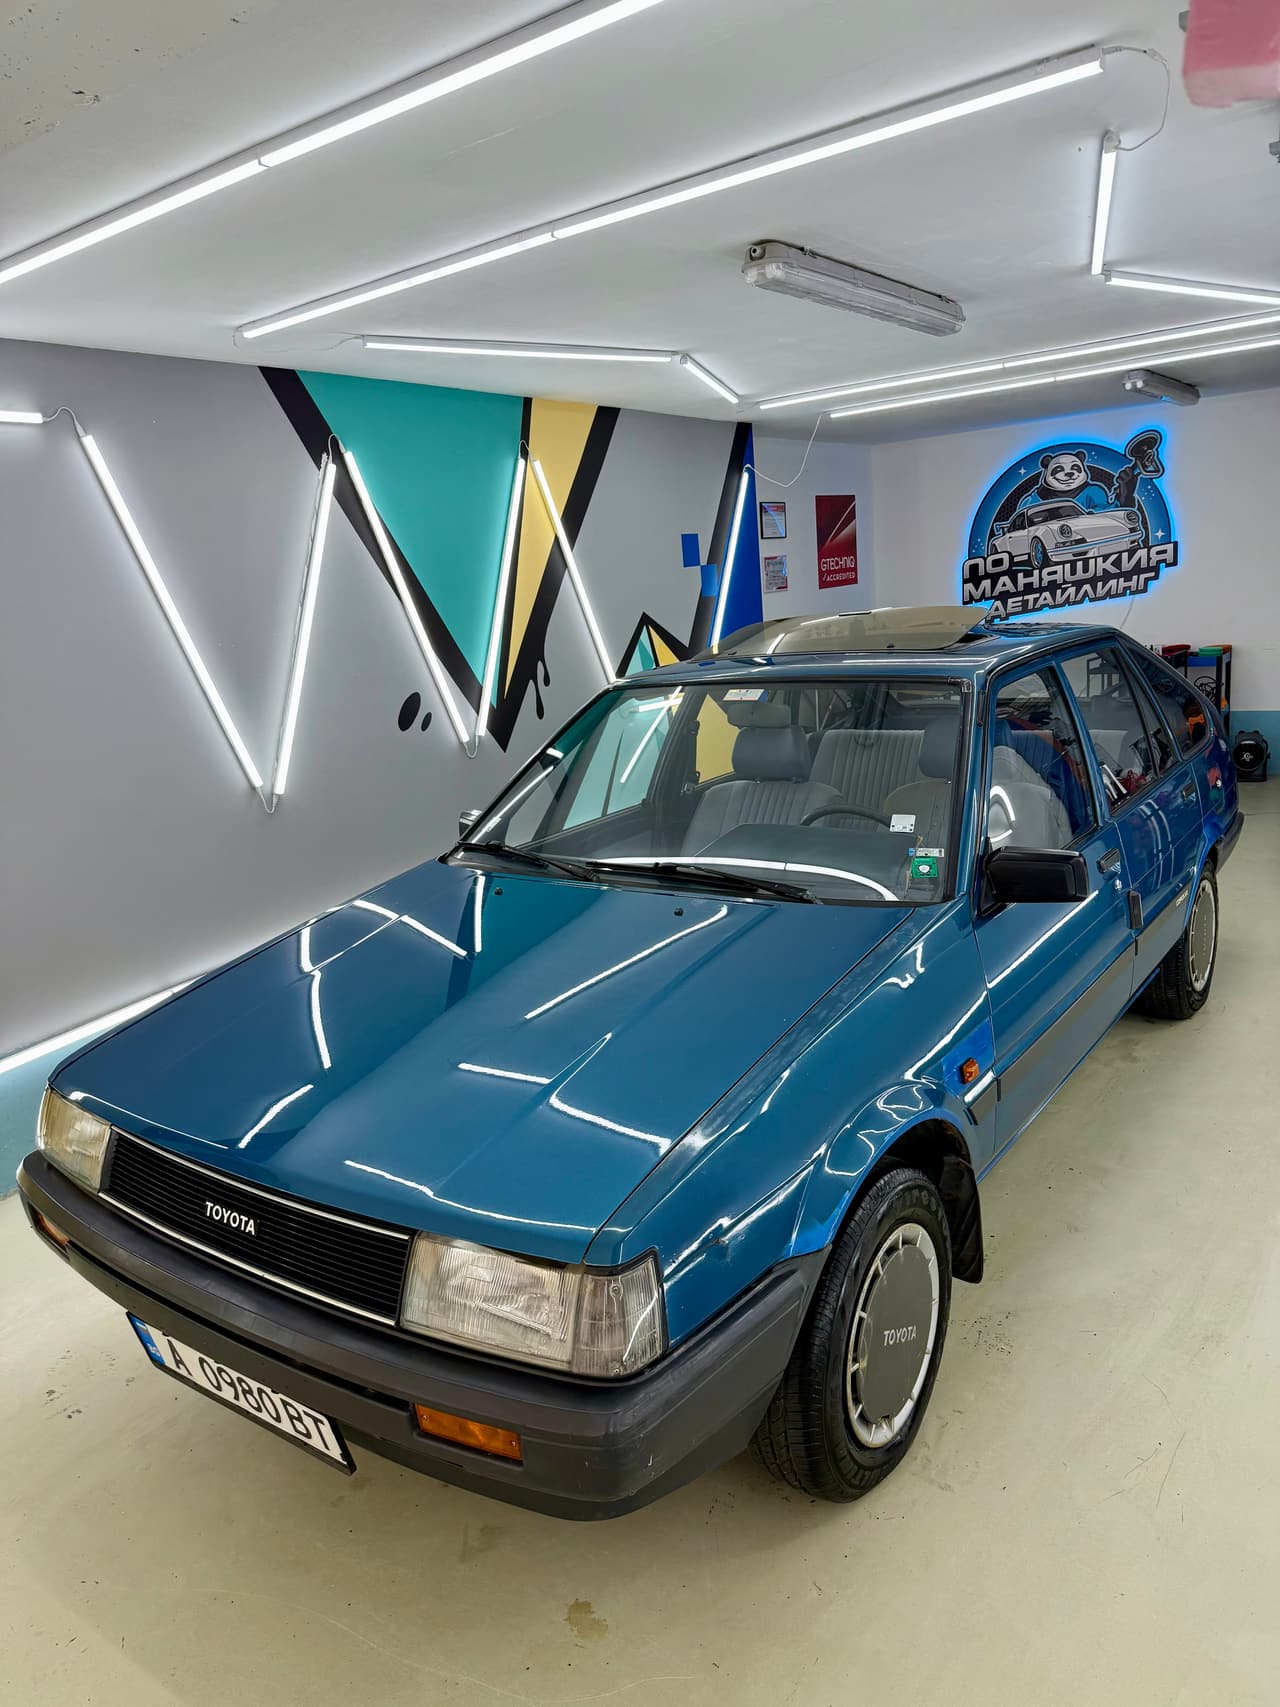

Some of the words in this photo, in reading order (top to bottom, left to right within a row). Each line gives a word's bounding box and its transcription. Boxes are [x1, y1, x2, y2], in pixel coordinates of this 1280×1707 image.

[820, 555, 855, 571] GTECHNIQ
[825, 571, 856, 582] ACCREDITED
[963, 553, 1028, 579] ПО-
[964, 543, 1175, 602] МАНЯШКИЯ
[986, 572, 1155, 620] ДЕТАЙЛИНГ
[205, 1201, 256, 1236] TOYOTA
[883, 1325, 917, 1347] TOYOTA
[167, 1339, 193, 1377] A
